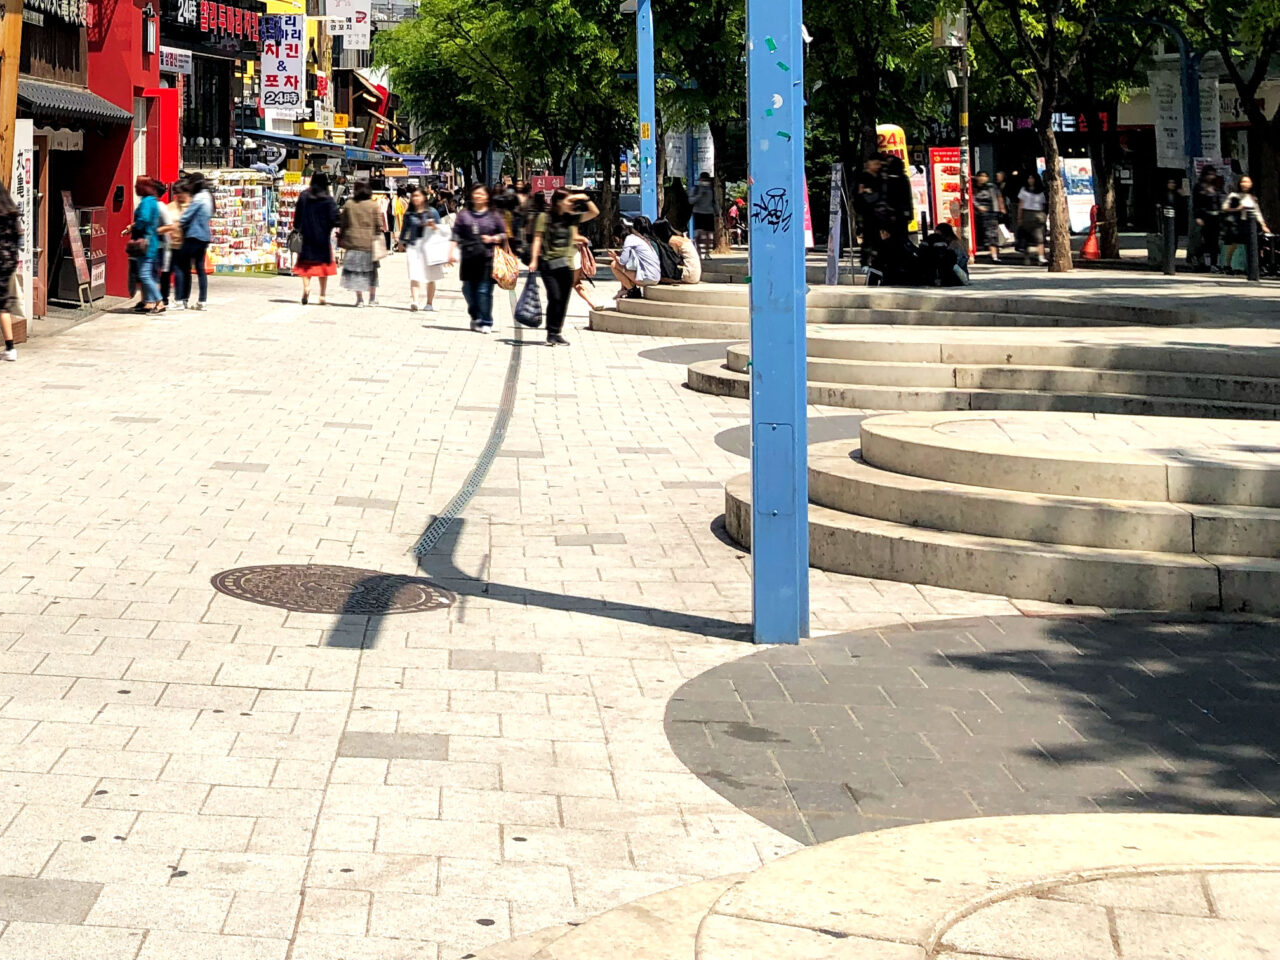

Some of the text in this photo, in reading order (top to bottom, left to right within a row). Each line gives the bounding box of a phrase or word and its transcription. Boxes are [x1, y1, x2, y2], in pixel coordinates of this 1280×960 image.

[265, 43, 299, 59] 치킨
[276, 60, 288, 72] &
[264, 75, 300, 91] 포차
[264, 91, 300, 105] 24時
